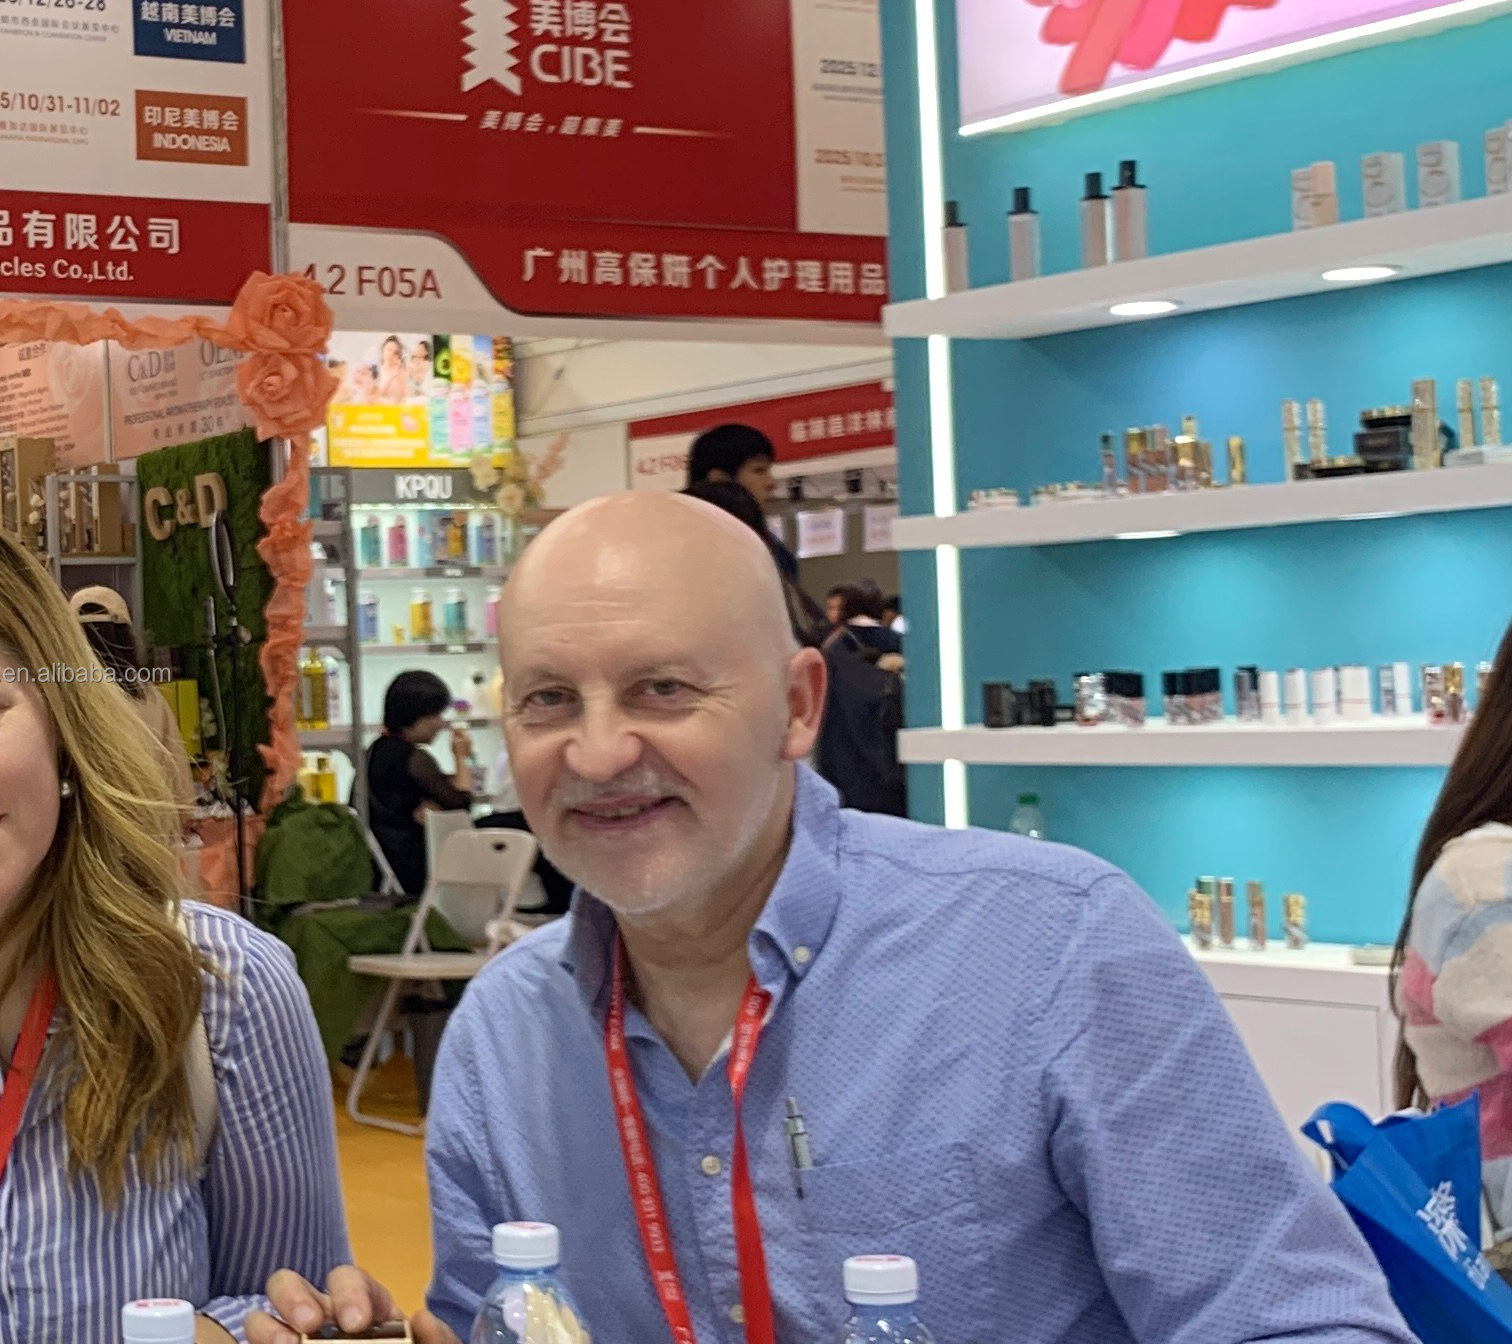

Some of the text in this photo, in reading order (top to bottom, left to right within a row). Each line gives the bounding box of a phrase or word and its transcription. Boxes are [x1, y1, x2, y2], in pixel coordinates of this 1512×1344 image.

[141, 0, 236, 28] 越南美博会
[163, 28, 218, 46] VIETNAM
[529, 42, 634, 89] CIBE
[144, 106, 239, 131] 印尼美博会
[153, 132, 232, 152] INDONESIA
[53, 259, 134, 283] Co.,Ltd.
[357, 265, 443, 299] F05A
[145, 472, 229, 541] C&D
